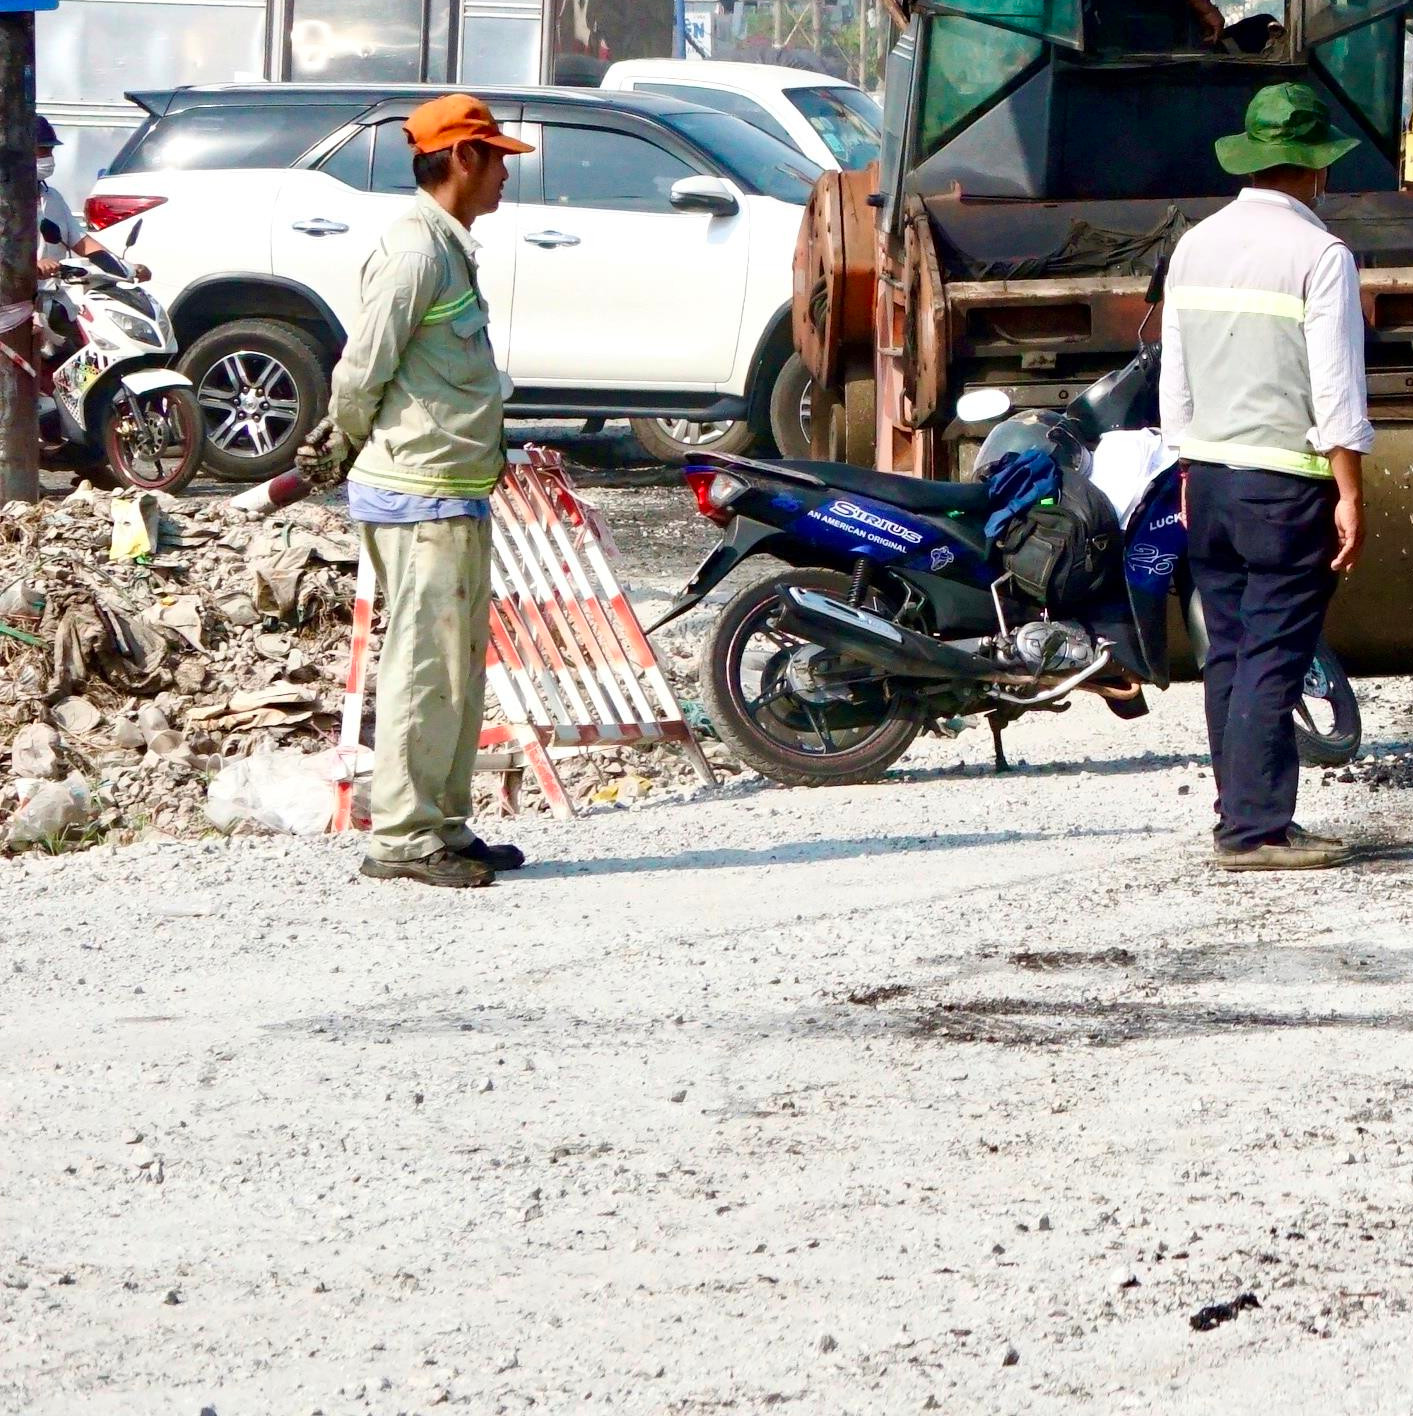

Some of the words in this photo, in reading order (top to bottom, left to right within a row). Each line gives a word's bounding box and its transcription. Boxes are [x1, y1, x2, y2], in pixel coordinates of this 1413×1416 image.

[807, 510, 822, 520] AN
[821, 516, 867, 538] AMERICAN
[867, 533, 908, 554] ORIGINAL
